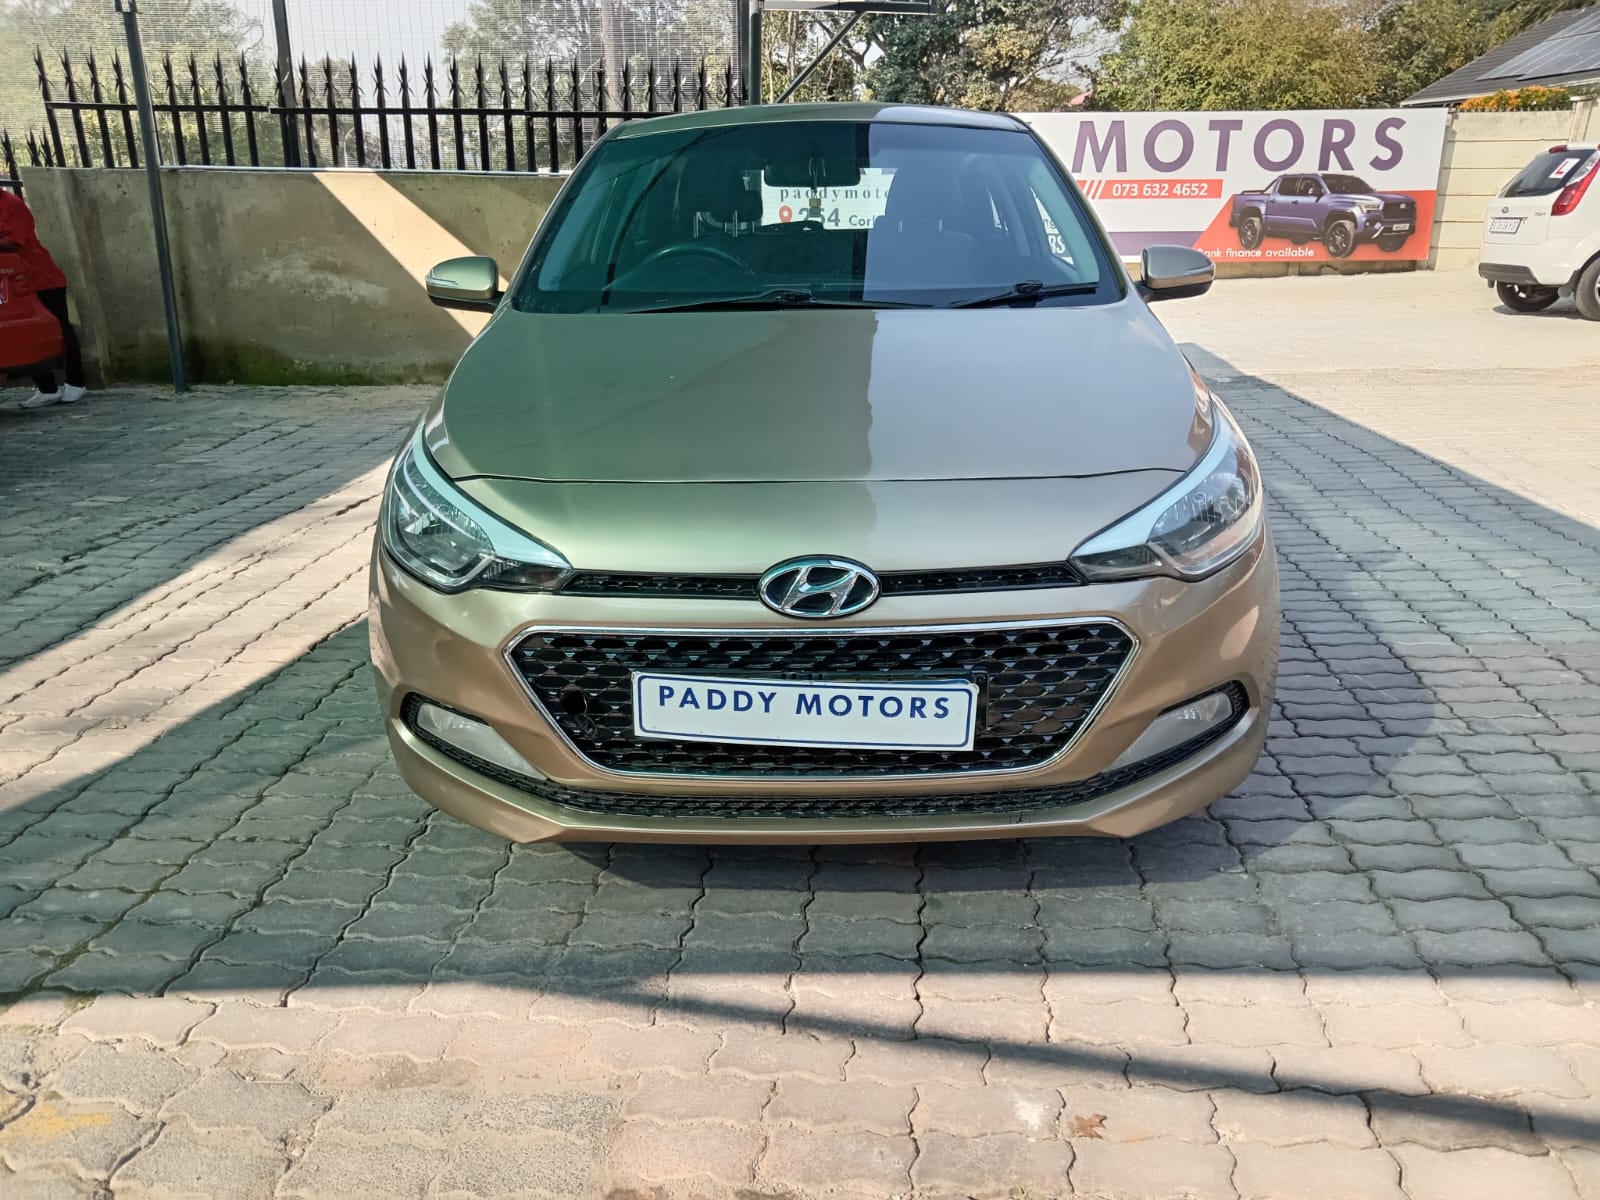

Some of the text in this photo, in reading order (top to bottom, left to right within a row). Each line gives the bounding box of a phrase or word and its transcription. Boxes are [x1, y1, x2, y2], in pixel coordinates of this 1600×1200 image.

[1072, 117, 1406, 173] MOTORS
[1112, 183, 1208, 196] 073 632 4652
[848, 214, 876, 226] Cor
[1226, 247, 1262, 258] finance
[1265, 246, 1314, 258] available
[658, 685, 949, 719] PADDY MOTORS
